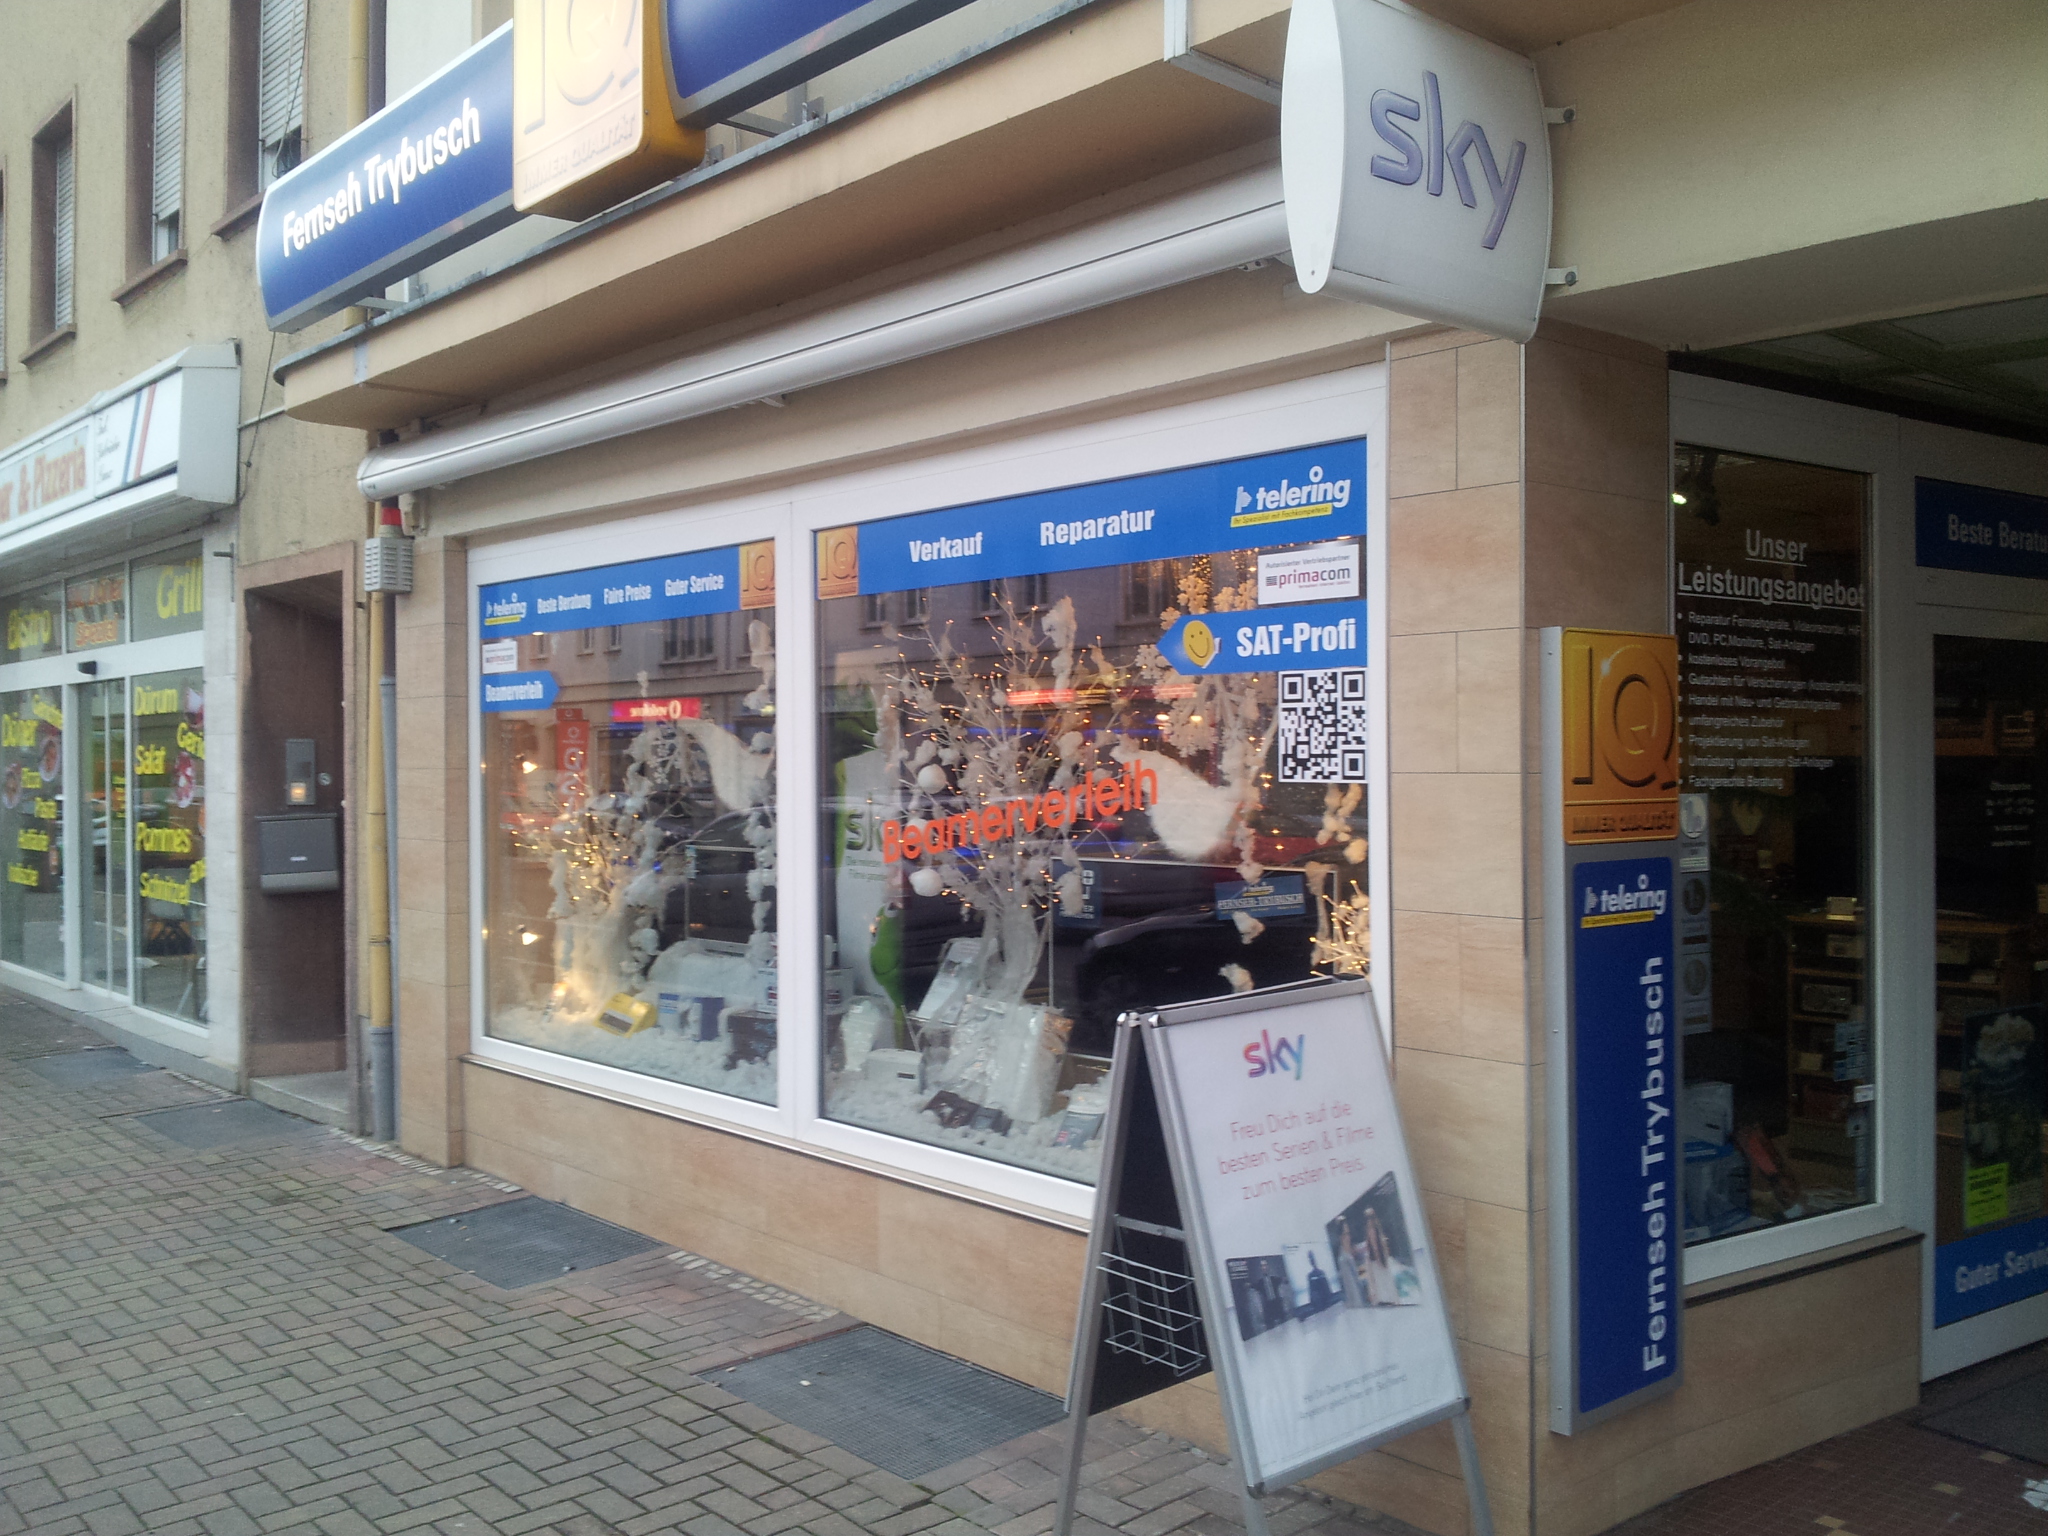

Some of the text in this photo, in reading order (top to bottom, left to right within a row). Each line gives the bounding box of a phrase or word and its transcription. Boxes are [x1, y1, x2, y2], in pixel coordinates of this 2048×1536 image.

[282, 97, 481, 258] Fernseh Trybusch
[1370, 69, 1527, 250] sky
[1255, 465, 1351, 511] telering
[908, 507, 1156, 564] Verkauf Reparatur
[1746, 528, 1808, 563] Unser
[1948, 514, 1993, 547] Beste
[156, 556, 203, 619] Grill
[689, 572, 724, 595] Service
[1278, 566, 1351, 589] primacom
[1677, 562, 1866, 610] Leistungsangebot
[1236, 617, 1357, 658] SAT-Profi
[1571, 643, 1678, 791] IQ
[882, 759, 1159, 865] Beamerverleih
[1600, 874, 1668, 915] telering
[1243, 1029, 1306, 1081] sky
[1229, 1099, 1352, 1142] Freu Dich auf die
[1218, 1123, 1375, 1176] besten Serien & Filme
[1639, 955, 1671, 1373] Fernseh Trybusch
[1241, 1179, 1276, 1200] zum
[1280, 1166, 1328, 1192] besten
[1328, 1156, 1367, 1184] Preis.
